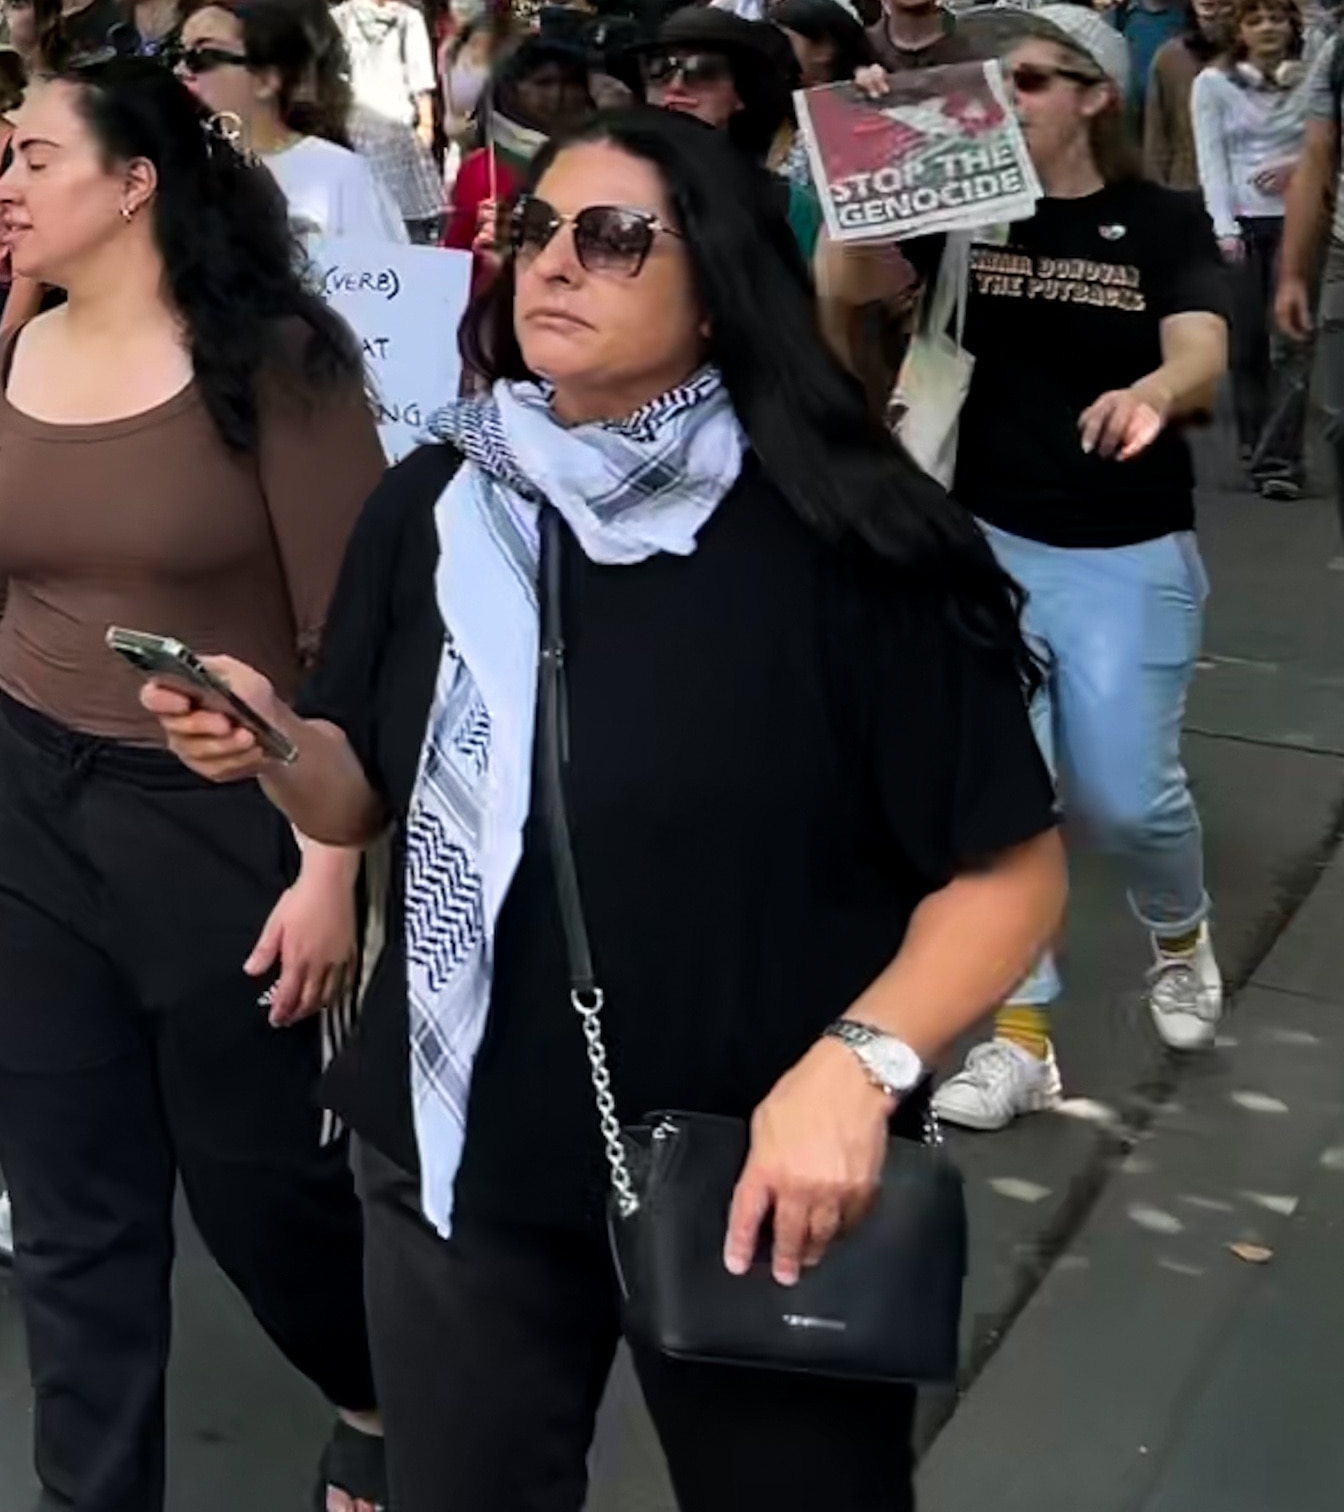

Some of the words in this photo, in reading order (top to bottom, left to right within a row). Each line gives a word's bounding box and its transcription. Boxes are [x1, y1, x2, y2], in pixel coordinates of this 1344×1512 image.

[828, 161, 925, 203] STOP
[936, 143, 1013, 177] THE
[839, 167, 1021, 227] GENOCIDE
[325, 265, 400, 300] (VERB)
